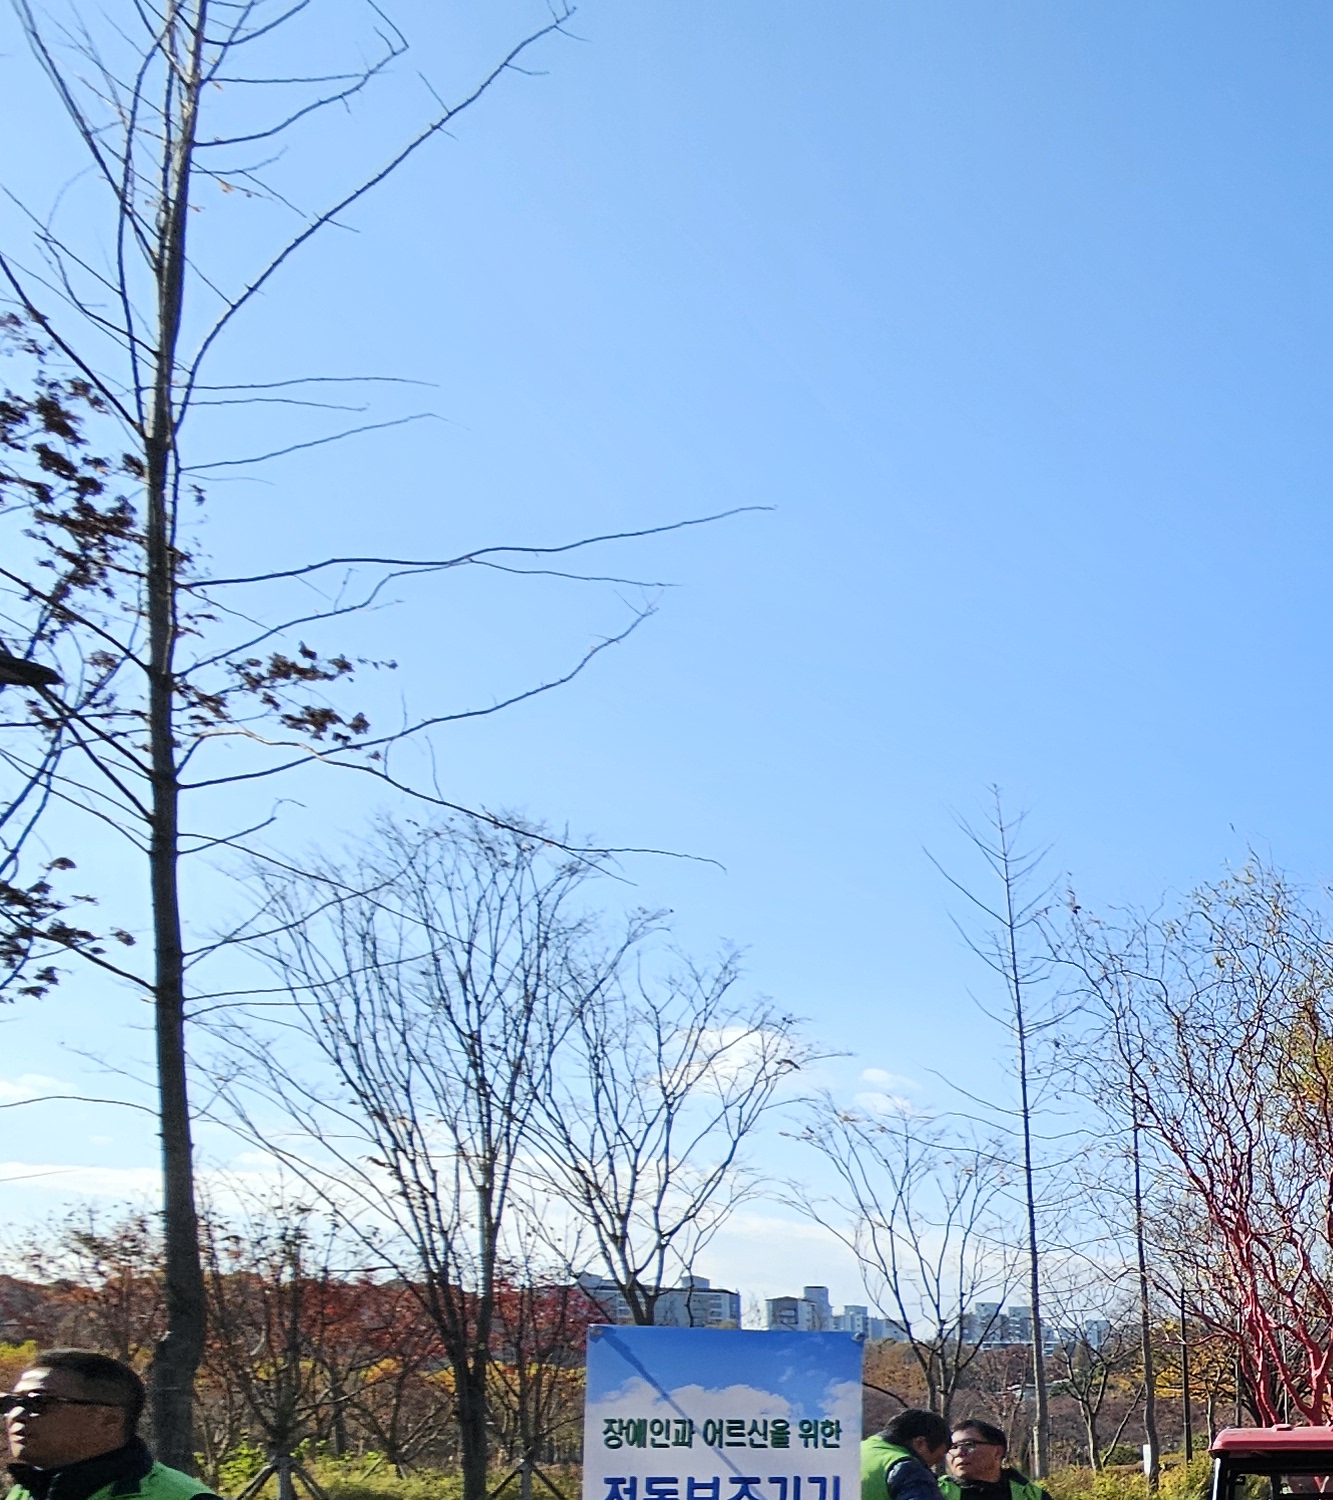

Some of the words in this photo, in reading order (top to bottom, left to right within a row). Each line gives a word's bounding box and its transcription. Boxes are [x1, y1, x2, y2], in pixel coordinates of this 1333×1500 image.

[602, 1418, 695, 1449] 장애인과
[702, 1418, 791, 1449] 어르신을
[798, 1418, 842, 1449] 위한
